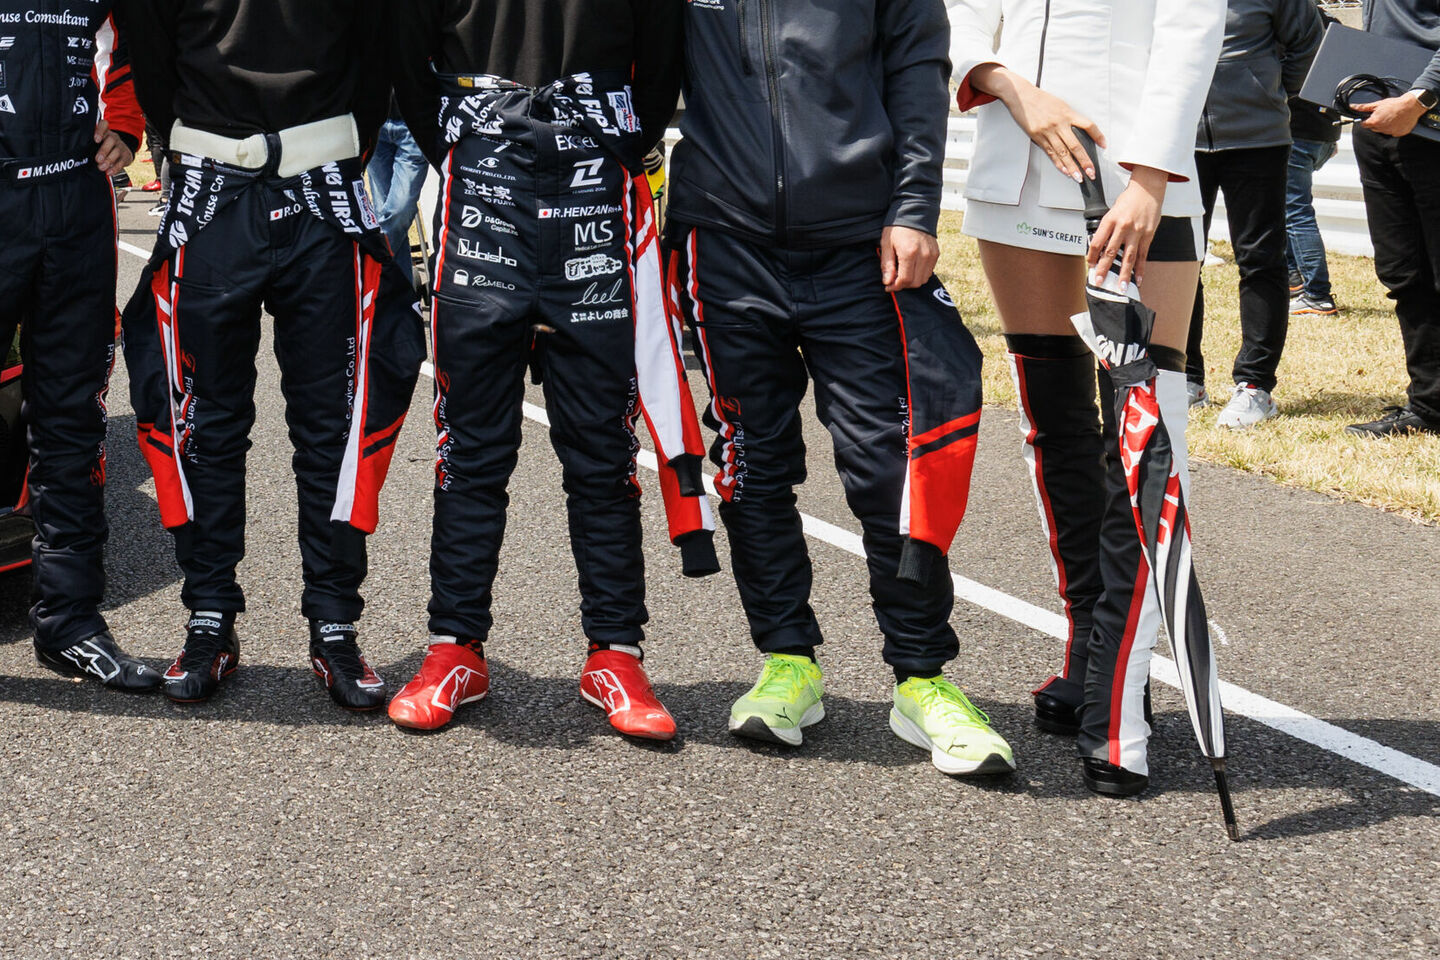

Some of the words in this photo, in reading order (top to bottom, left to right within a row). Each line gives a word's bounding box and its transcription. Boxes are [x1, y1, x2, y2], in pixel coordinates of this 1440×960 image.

[32, 159, 75, 177] M.KANO
[329, 190, 363, 235] FIRST
[553, 204, 609, 219] R.HENZAN
[1032, 227, 1054, 239] SUN'S
[1055, 232, 1083, 245] CREATE
[468, 241, 518, 267] daisho
